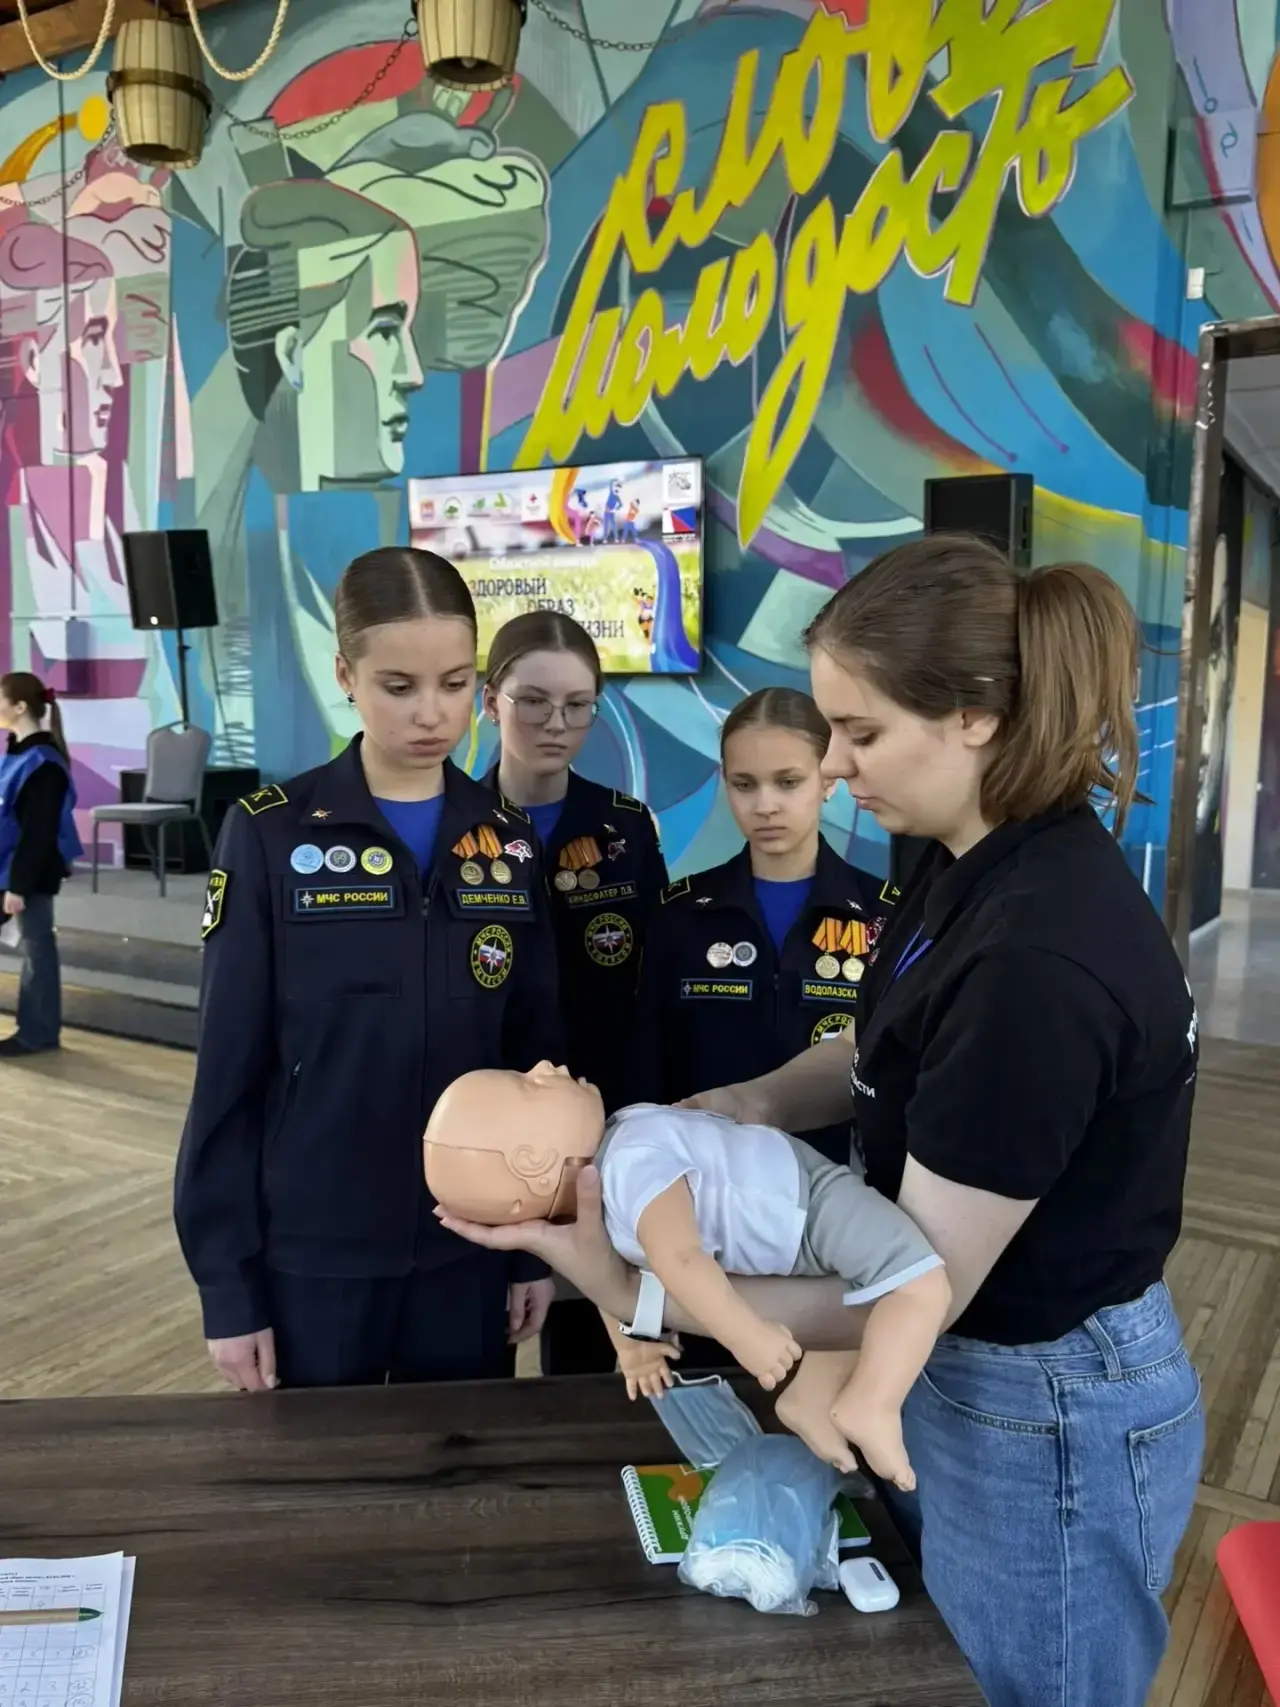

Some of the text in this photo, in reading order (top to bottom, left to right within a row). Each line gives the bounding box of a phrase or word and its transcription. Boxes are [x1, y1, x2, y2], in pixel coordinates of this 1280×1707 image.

[468, 575, 547, 597] ЗДОРОВЫЙ
[580, 619, 624, 638] ИЗНИ
[316, 891, 388, 904] МЧС РОССИИ
[461, 893, 510, 904] ДЕМЧЕНКО
[692, 984, 748, 994] МЧС РОССИИ
[816, 1017, 833, 1033] МЧС
